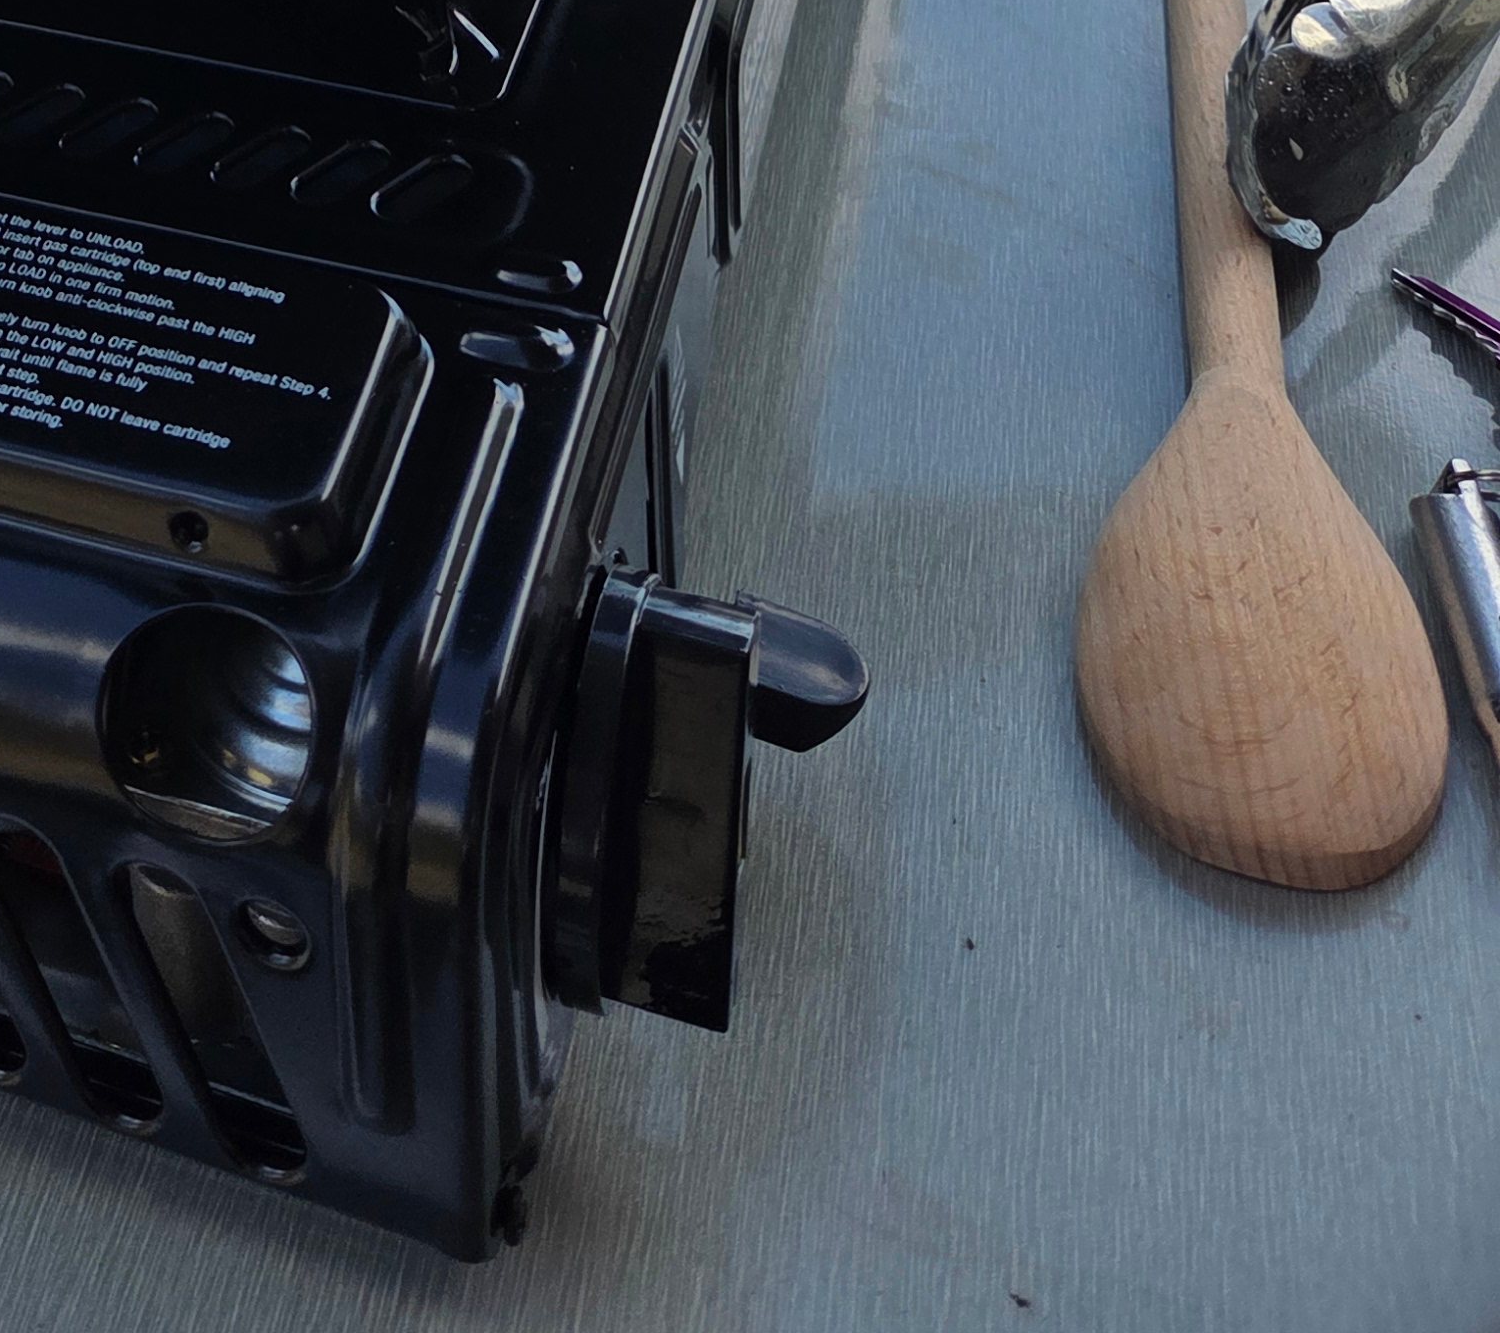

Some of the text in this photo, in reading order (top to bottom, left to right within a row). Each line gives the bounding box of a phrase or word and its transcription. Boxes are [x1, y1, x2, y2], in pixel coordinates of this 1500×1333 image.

[9, 215, 32, 229] the
[33, 220, 68, 236] lever
[69, 228, 84, 240] to
[86, 231, 144, 255] UNLOAD.
[2, 229, 42, 247] insert
[42, 240, 68, 252] gas
[70, 246, 131, 267] cartridge
[133, 258, 161, 275] (top
[163, 267, 192, 280] end
[193, 271, 226, 290] first)
[228, 281, 286, 304] aligning
[13, 247, 35, 261] tab
[37, 254, 55, 266] on
[57, 259, 125, 282] appliance.
[6, 330, 29, 345] the
[31, 335, 67, 353] LOW
[66, 346, 96, 360] and
[96, 350, 134, 369] HIGH
[133, 362, 195, 384] position.
[6, 367, 40, 384] step.
